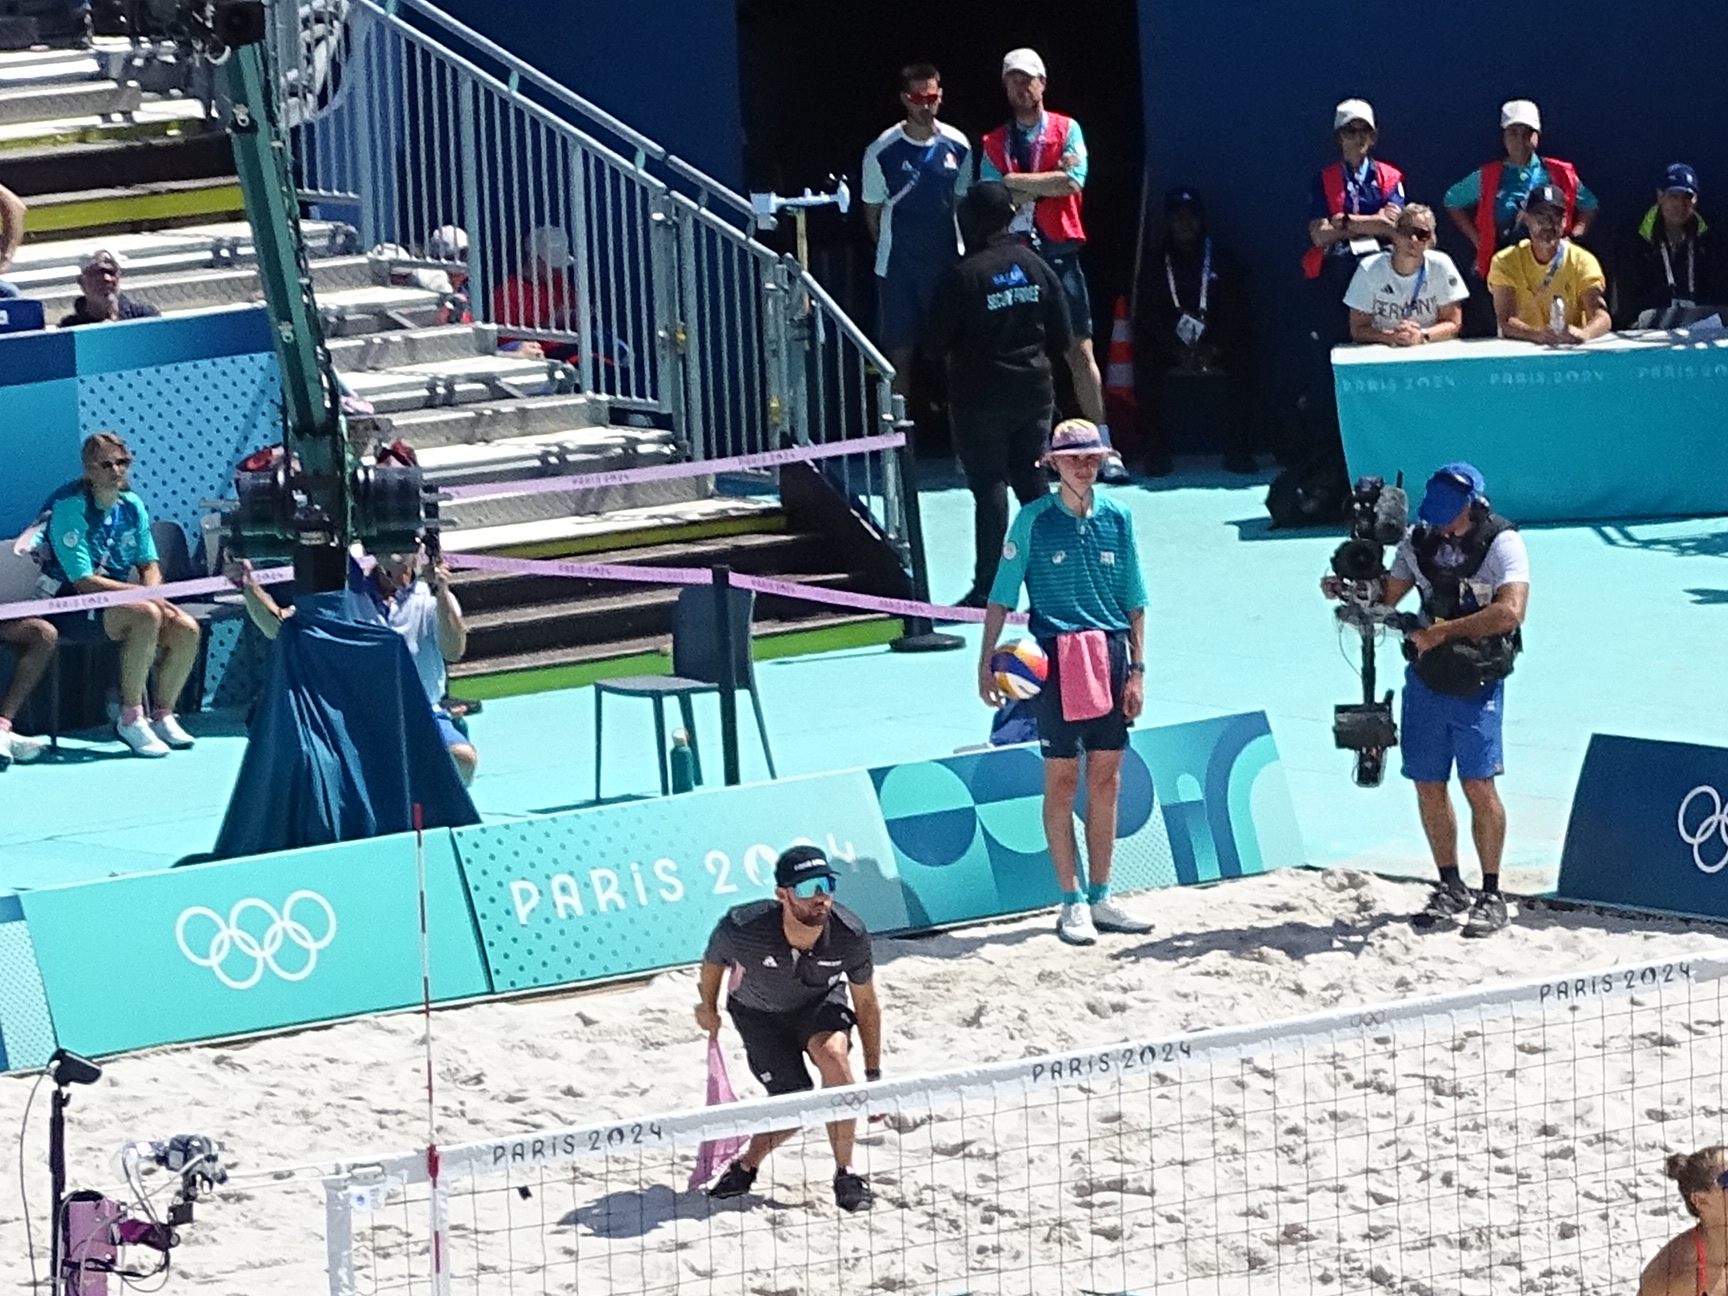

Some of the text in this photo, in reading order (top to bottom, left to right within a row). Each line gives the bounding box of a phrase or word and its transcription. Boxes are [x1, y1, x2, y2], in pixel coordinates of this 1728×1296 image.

[508, 833, 859, 926] PARIS 204
[1540, 963, 1691, 1003] PARIS 2024
[1031, 1043, 1191, 1083] PARIS 2024
[493, 1123, 662, 1165] PARIS 2024
